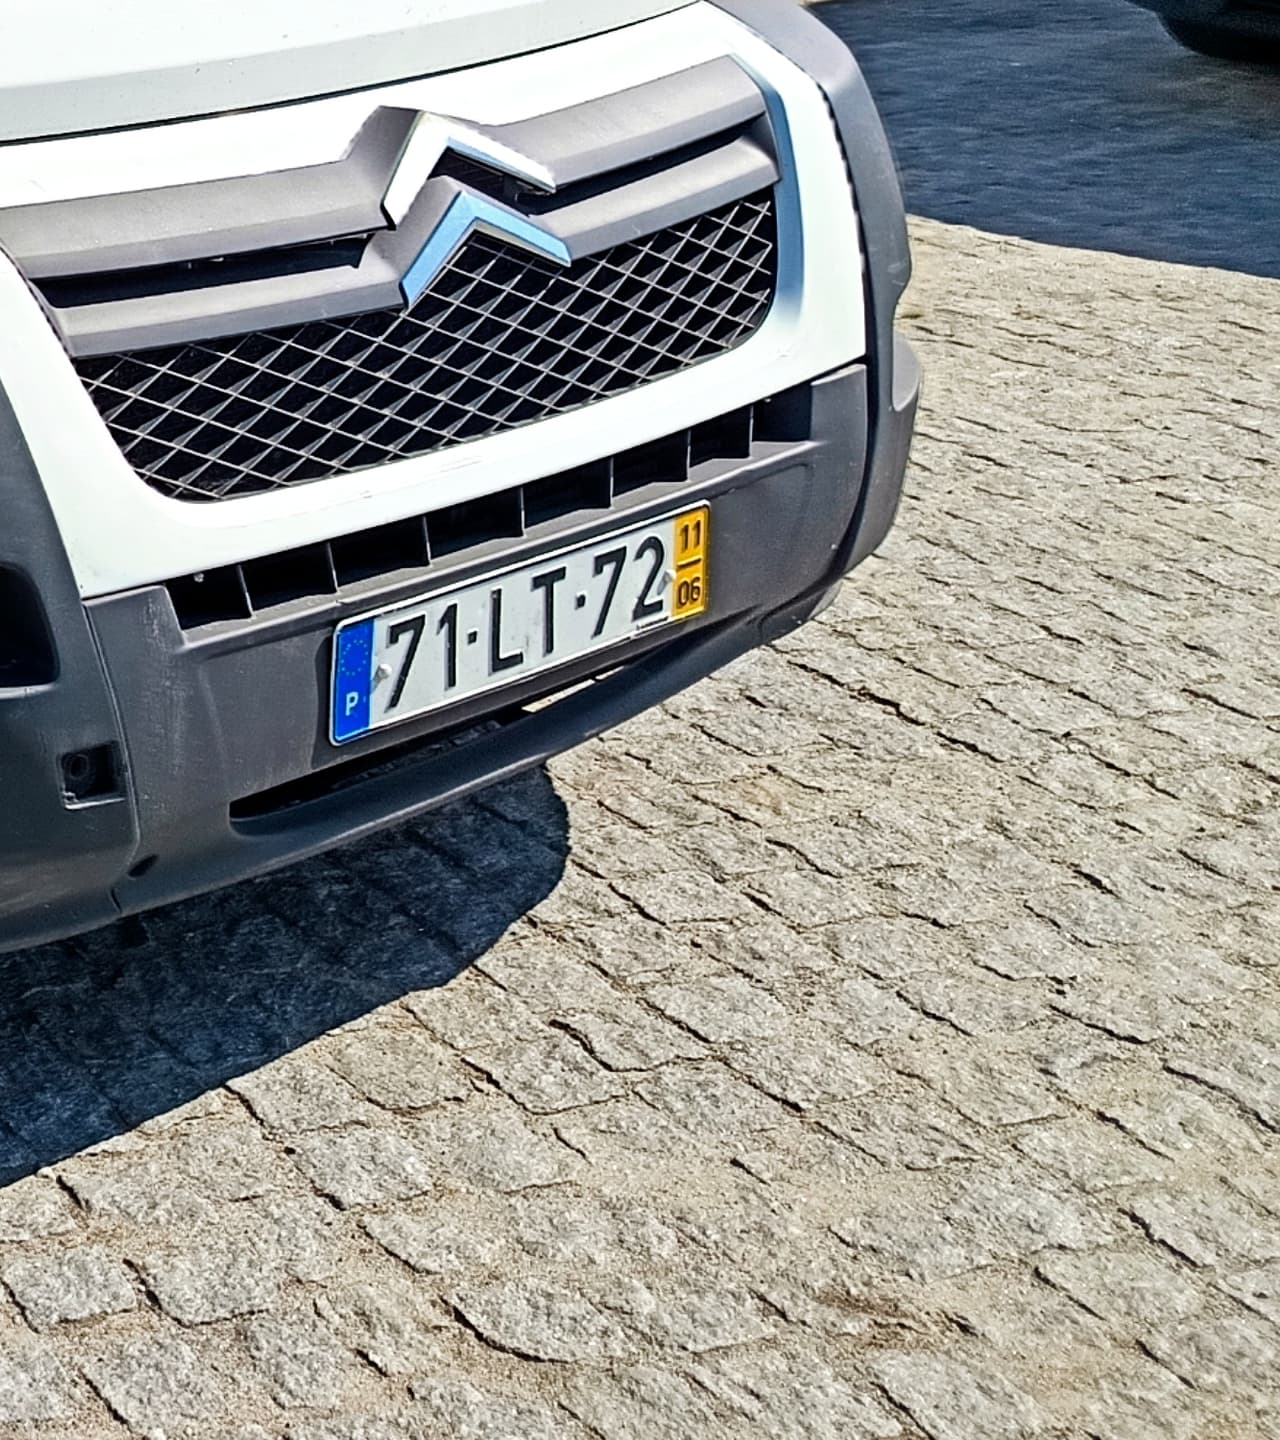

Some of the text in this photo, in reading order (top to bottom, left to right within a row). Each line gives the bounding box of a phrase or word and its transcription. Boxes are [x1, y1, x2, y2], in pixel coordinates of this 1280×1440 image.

[680, 520, 701, 552] 11
[679, 576, 701, 607] 06
[346, 691, 358, 716] P
